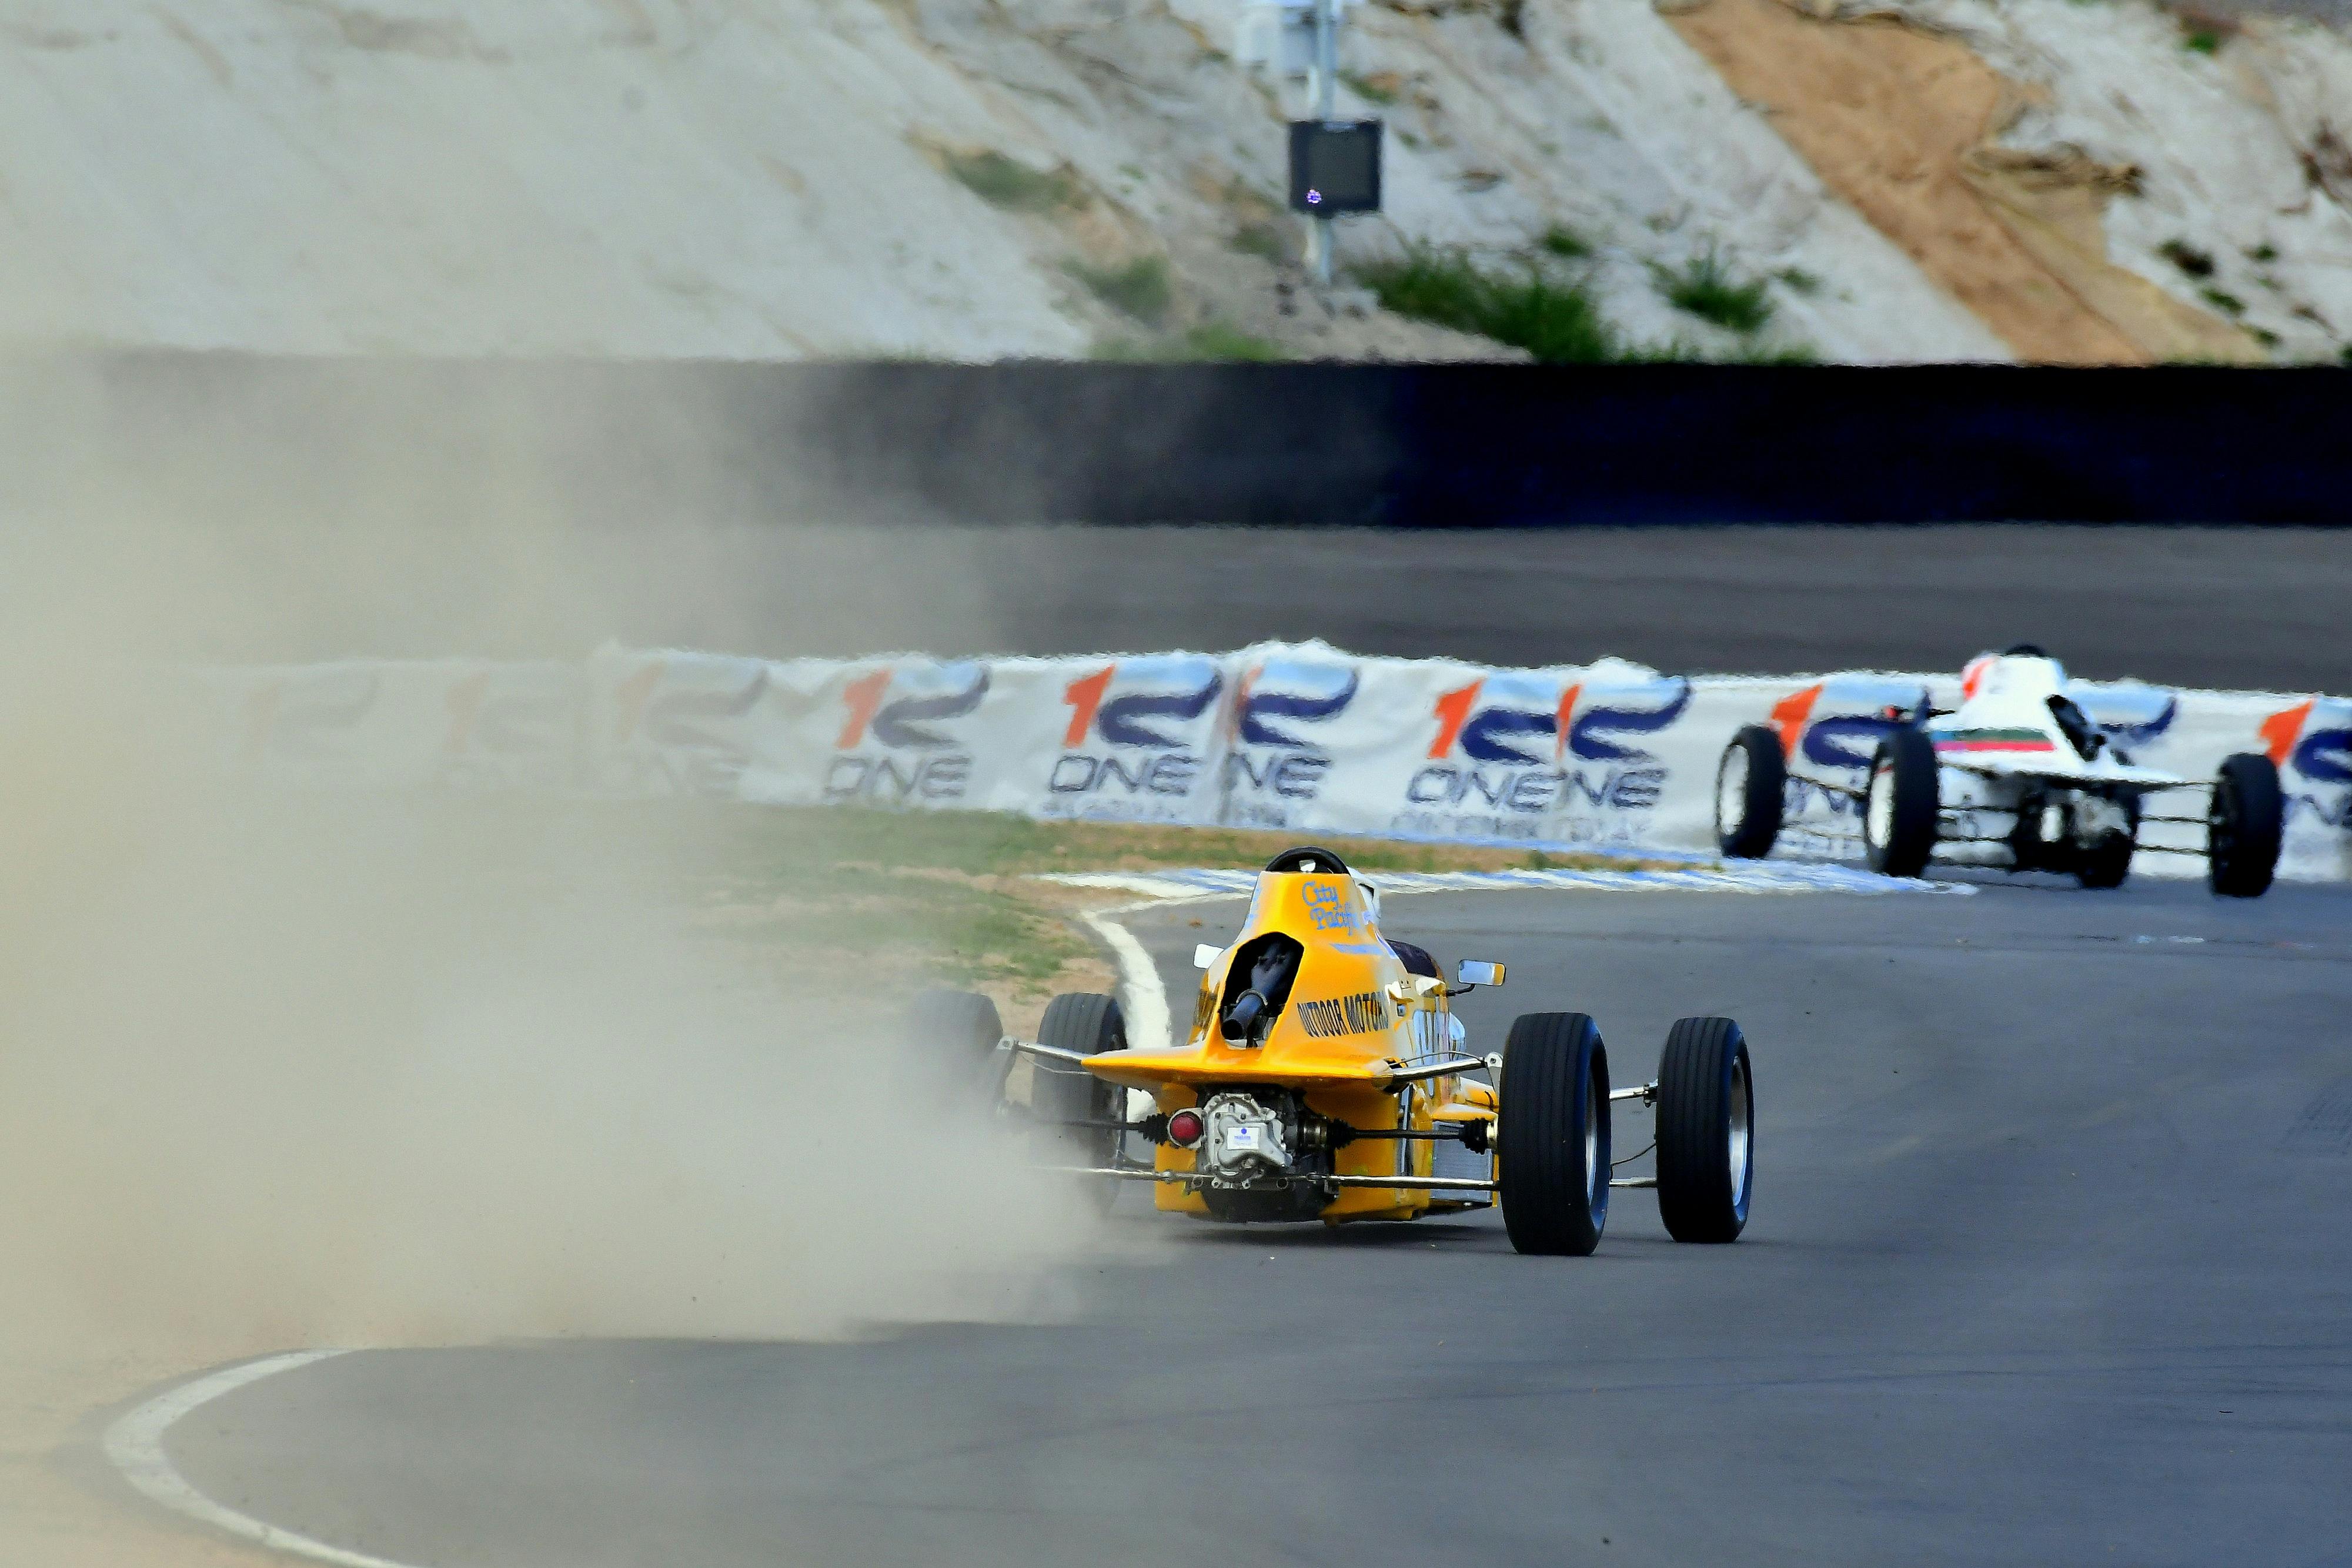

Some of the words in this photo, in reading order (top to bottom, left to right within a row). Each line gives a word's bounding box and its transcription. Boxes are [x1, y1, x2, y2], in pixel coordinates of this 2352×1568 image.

[824, 754, 971, 798] ONE
[1049, 753, 1201, 796] ONE
[1302, 880, 1341, 910] City
